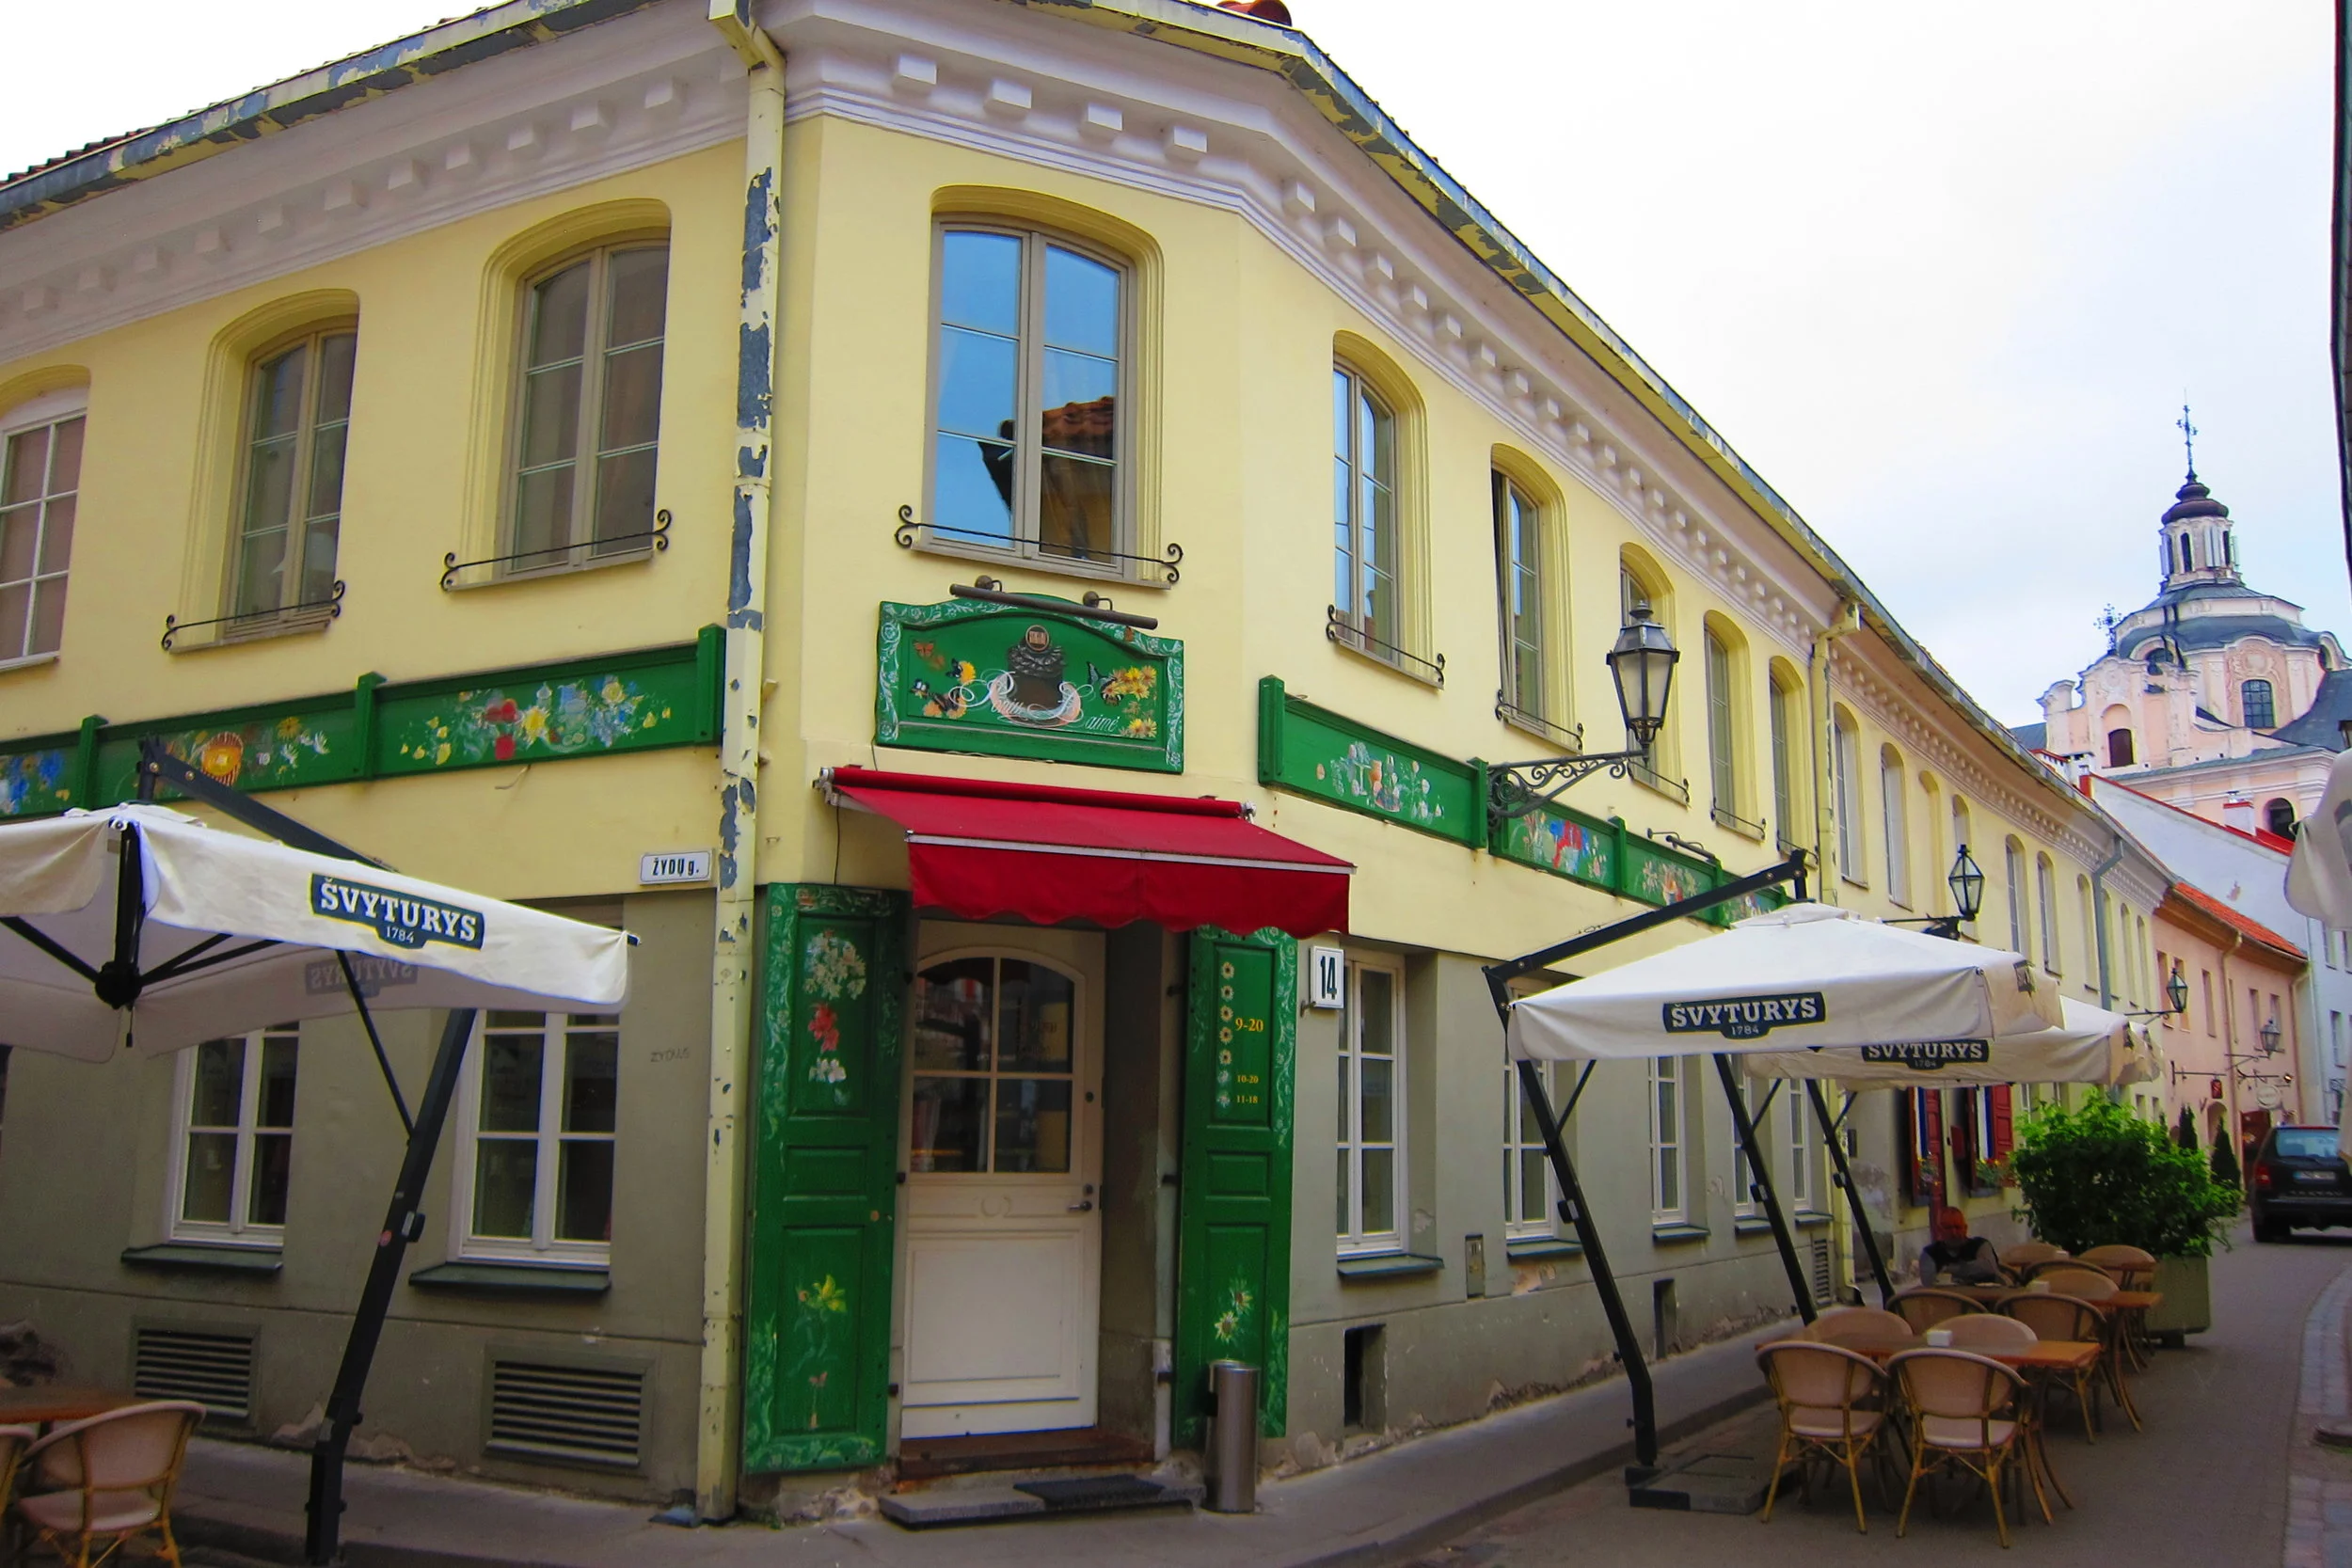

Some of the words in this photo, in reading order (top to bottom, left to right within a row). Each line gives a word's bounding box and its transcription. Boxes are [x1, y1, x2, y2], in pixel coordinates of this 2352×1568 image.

[688, 860, 699, 876] g.
[321, 877, 477, 942] ŠVYTURYS
[386, 926, 414, 944] 1784
[1320, 955, 1338, 1000] 14
[1671, 997, 1818, 1027] ŠVYTURYS
[1234, 1018, 1263, 1032] 9-20
[1731, 1024, 1759, 1036] 1784
[1237, 1074, 1259, 1084] 10-20
[1236, 1095, 1258, 1104] 11-18
